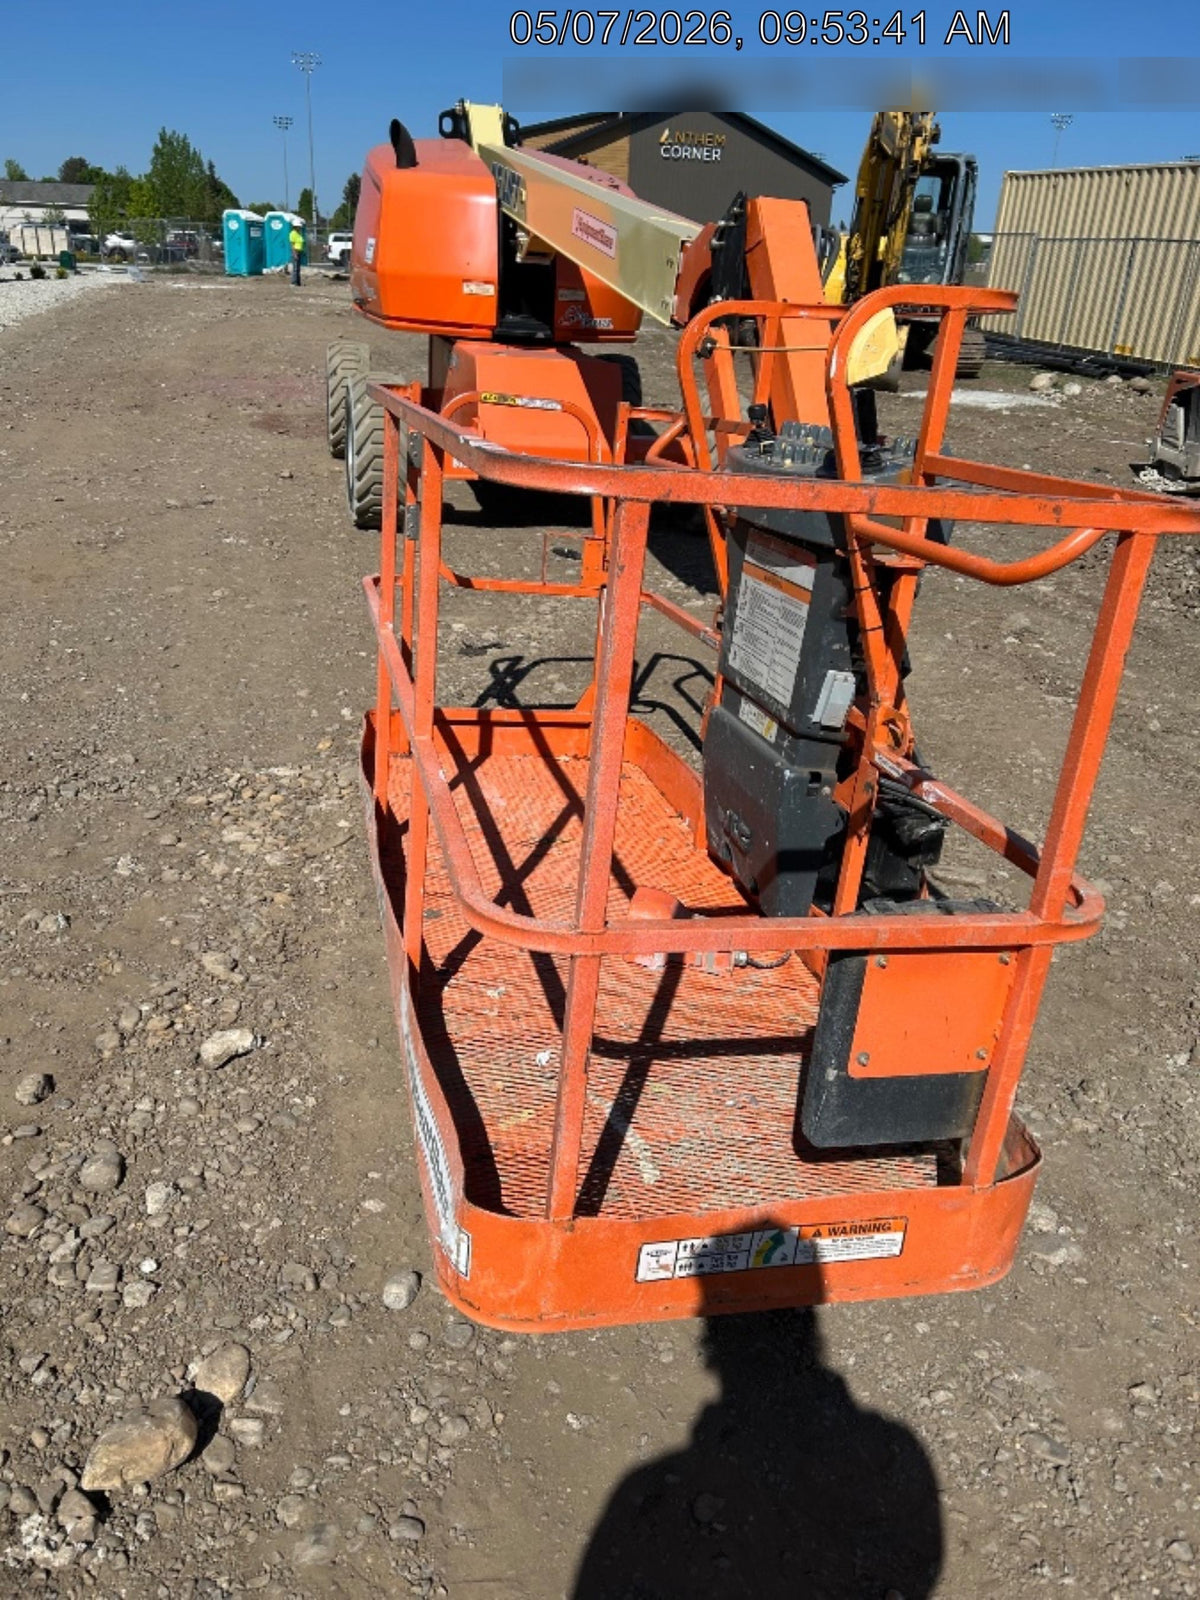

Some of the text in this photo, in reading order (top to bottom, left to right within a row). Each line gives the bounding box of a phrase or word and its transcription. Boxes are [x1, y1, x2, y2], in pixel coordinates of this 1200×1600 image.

[659, 127, 727, 147] ANTHEM
[660, 145, 721, 161] CORNER
[827, 1221, 892, 1237] WARNING
